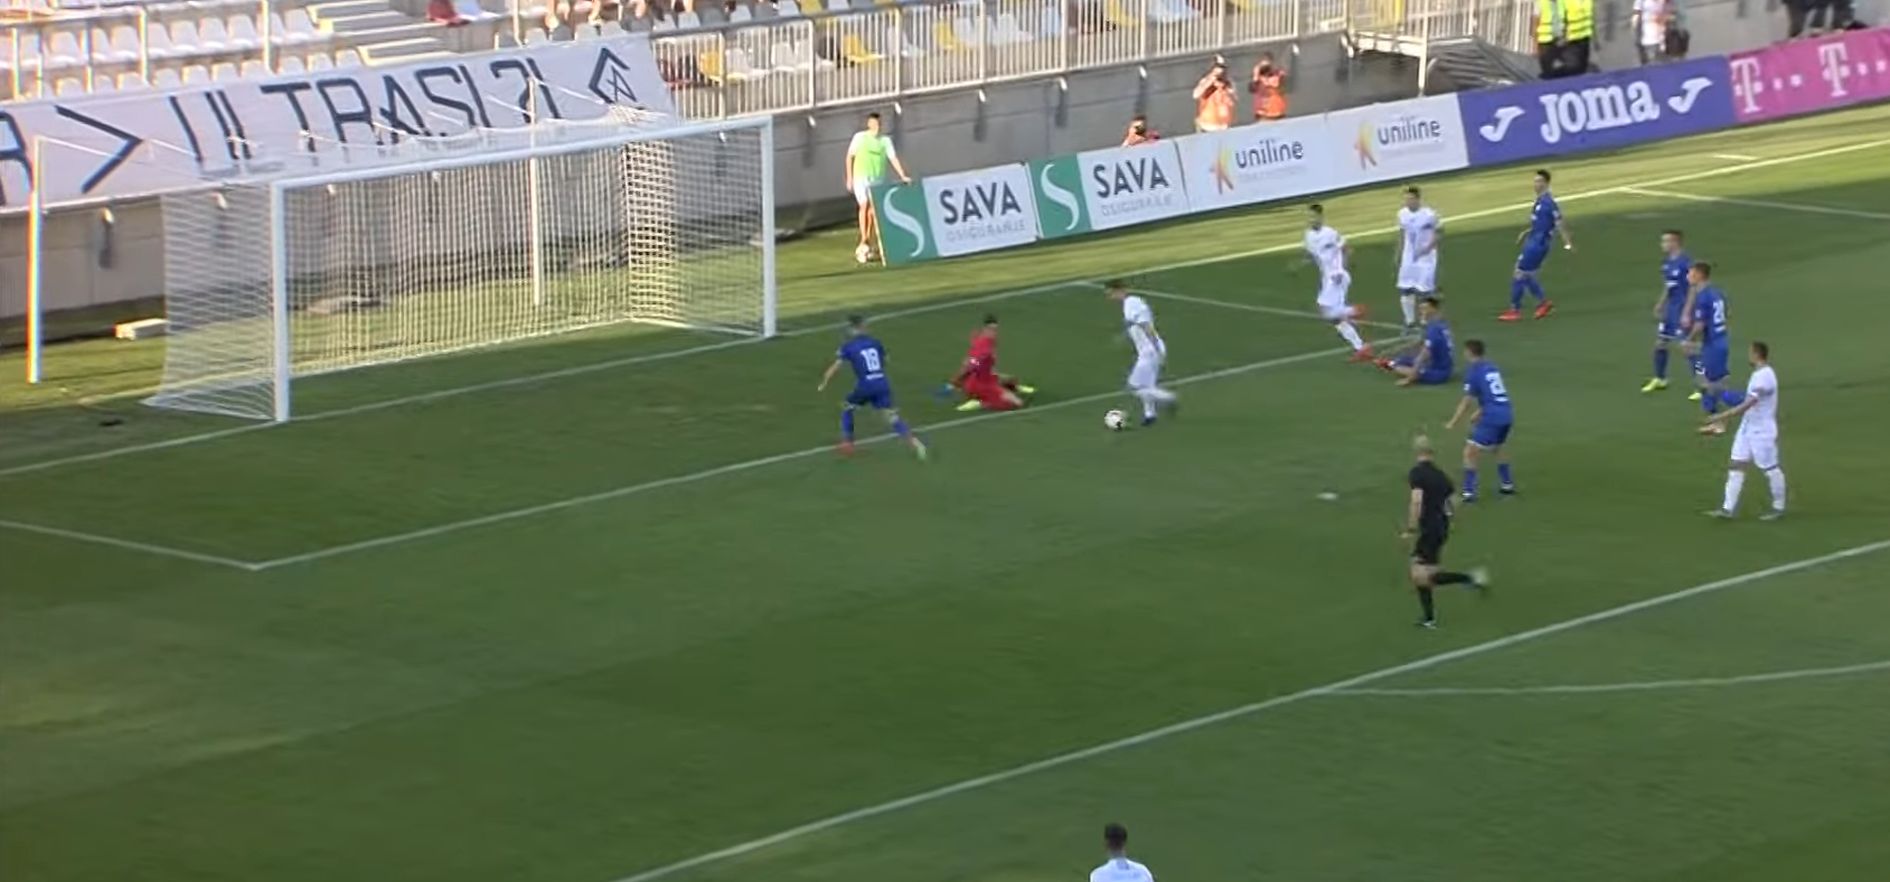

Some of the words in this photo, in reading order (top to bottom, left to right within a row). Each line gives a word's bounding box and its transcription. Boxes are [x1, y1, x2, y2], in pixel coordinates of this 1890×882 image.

[1377, 116, 1441, 145] uniline
[1235, 139, 1304, 169] uniline
[1093, 158, 1169, 199] SAVA
[939, 181, 1022, 225] SAVA
[861, 347, 881, 372] 18
